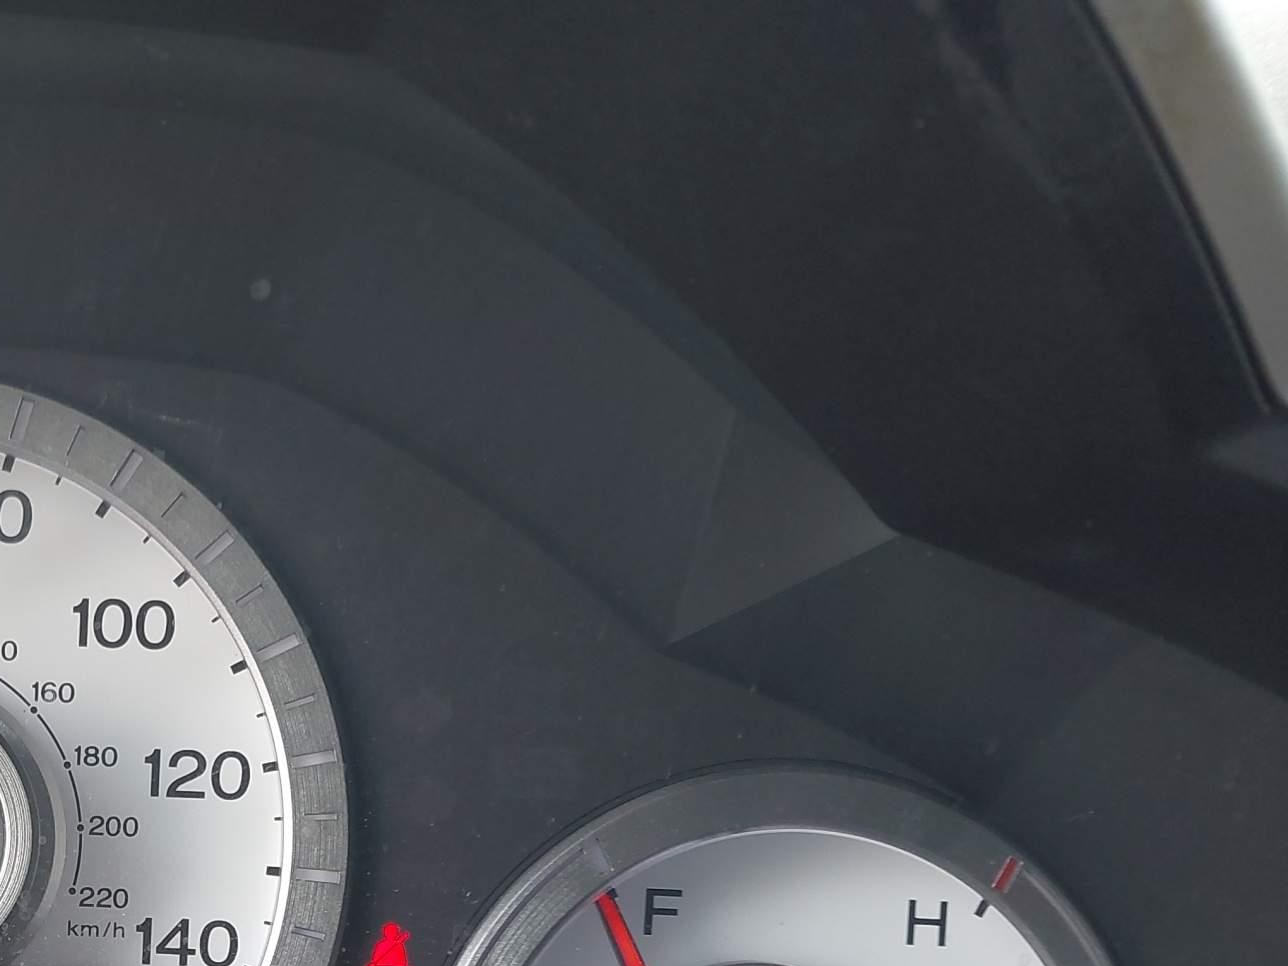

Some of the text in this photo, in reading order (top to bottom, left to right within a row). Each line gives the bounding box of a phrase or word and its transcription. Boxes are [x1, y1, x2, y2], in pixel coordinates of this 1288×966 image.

[72, 598, 175, 650] 100
[31, 682, 75, 704] 160
[74, 747, 118, 768] 180
[144, 748, 251, 801] 120
[88, 816, 139, 838] 200
[78, 887, 129, 909] 220
[642, 888, 683, 935] F
[906, 899, 947, 946] H
[67, 920, 125, 938] km/h
